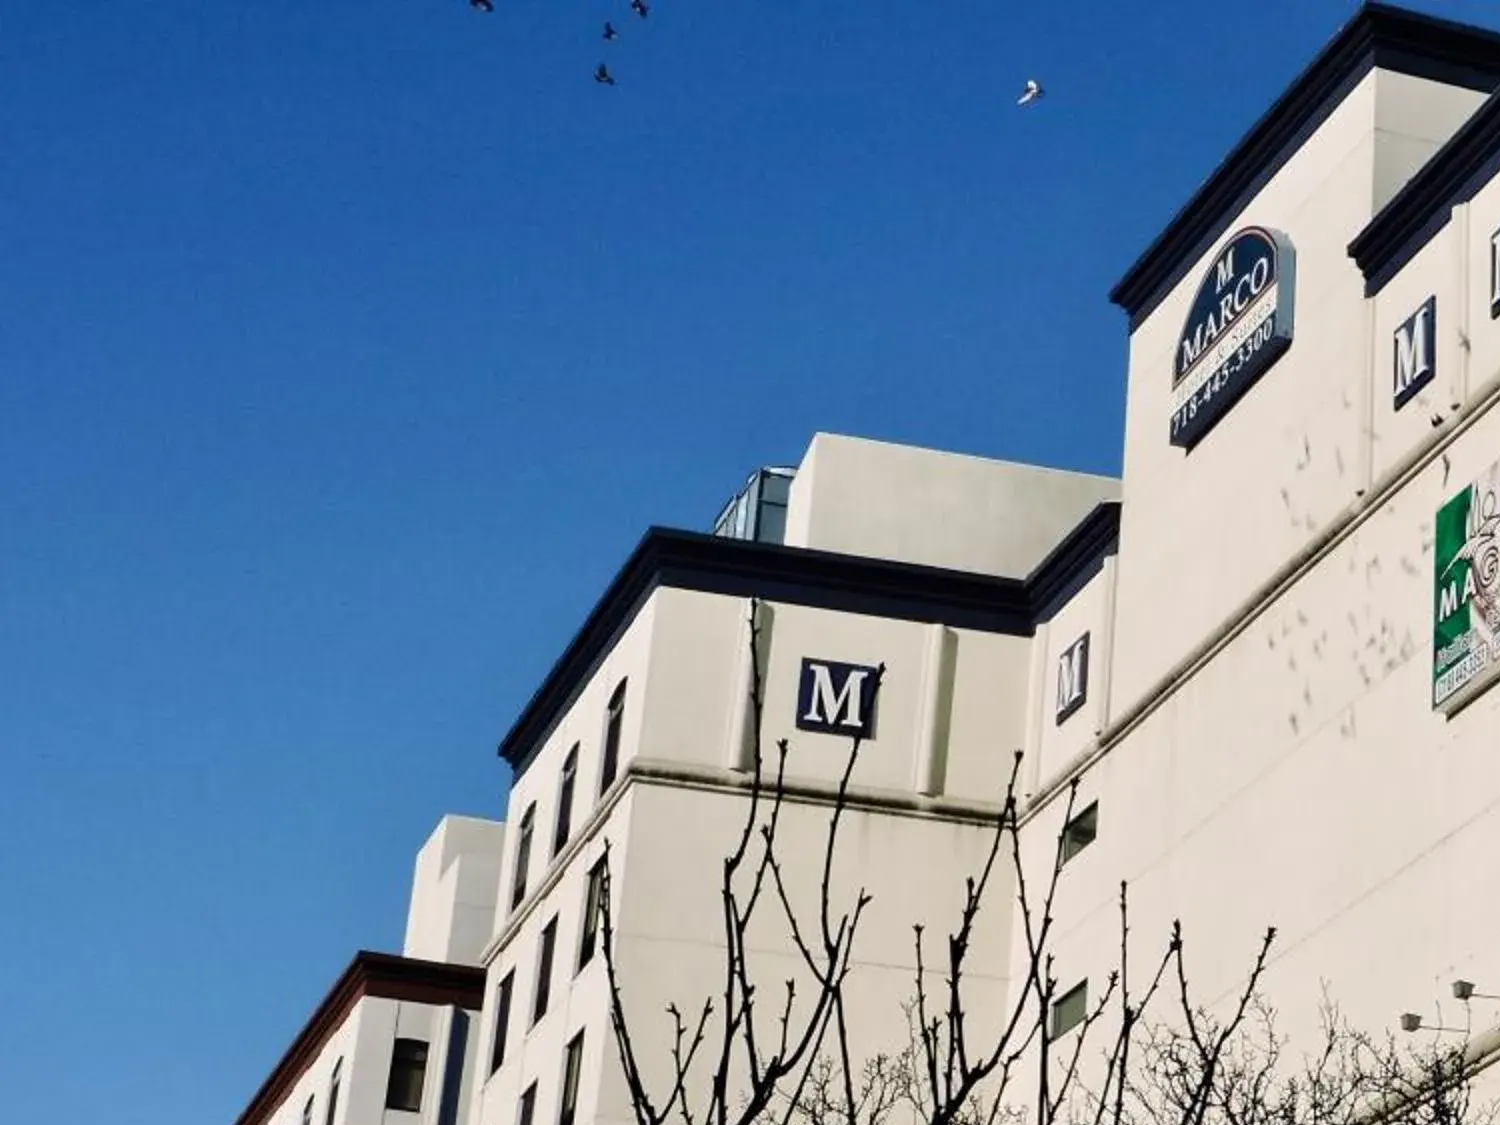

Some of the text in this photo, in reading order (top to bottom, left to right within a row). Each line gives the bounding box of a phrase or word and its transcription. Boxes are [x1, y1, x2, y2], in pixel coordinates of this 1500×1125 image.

[1180, 256, 1269, 372] MARCO
[1215, 246, 1234, 294] M
[1173, 317, 1274, 435] 718-445-3300
[1395, 307, 1429, 396] M
[803, 664, 868, 727] M
